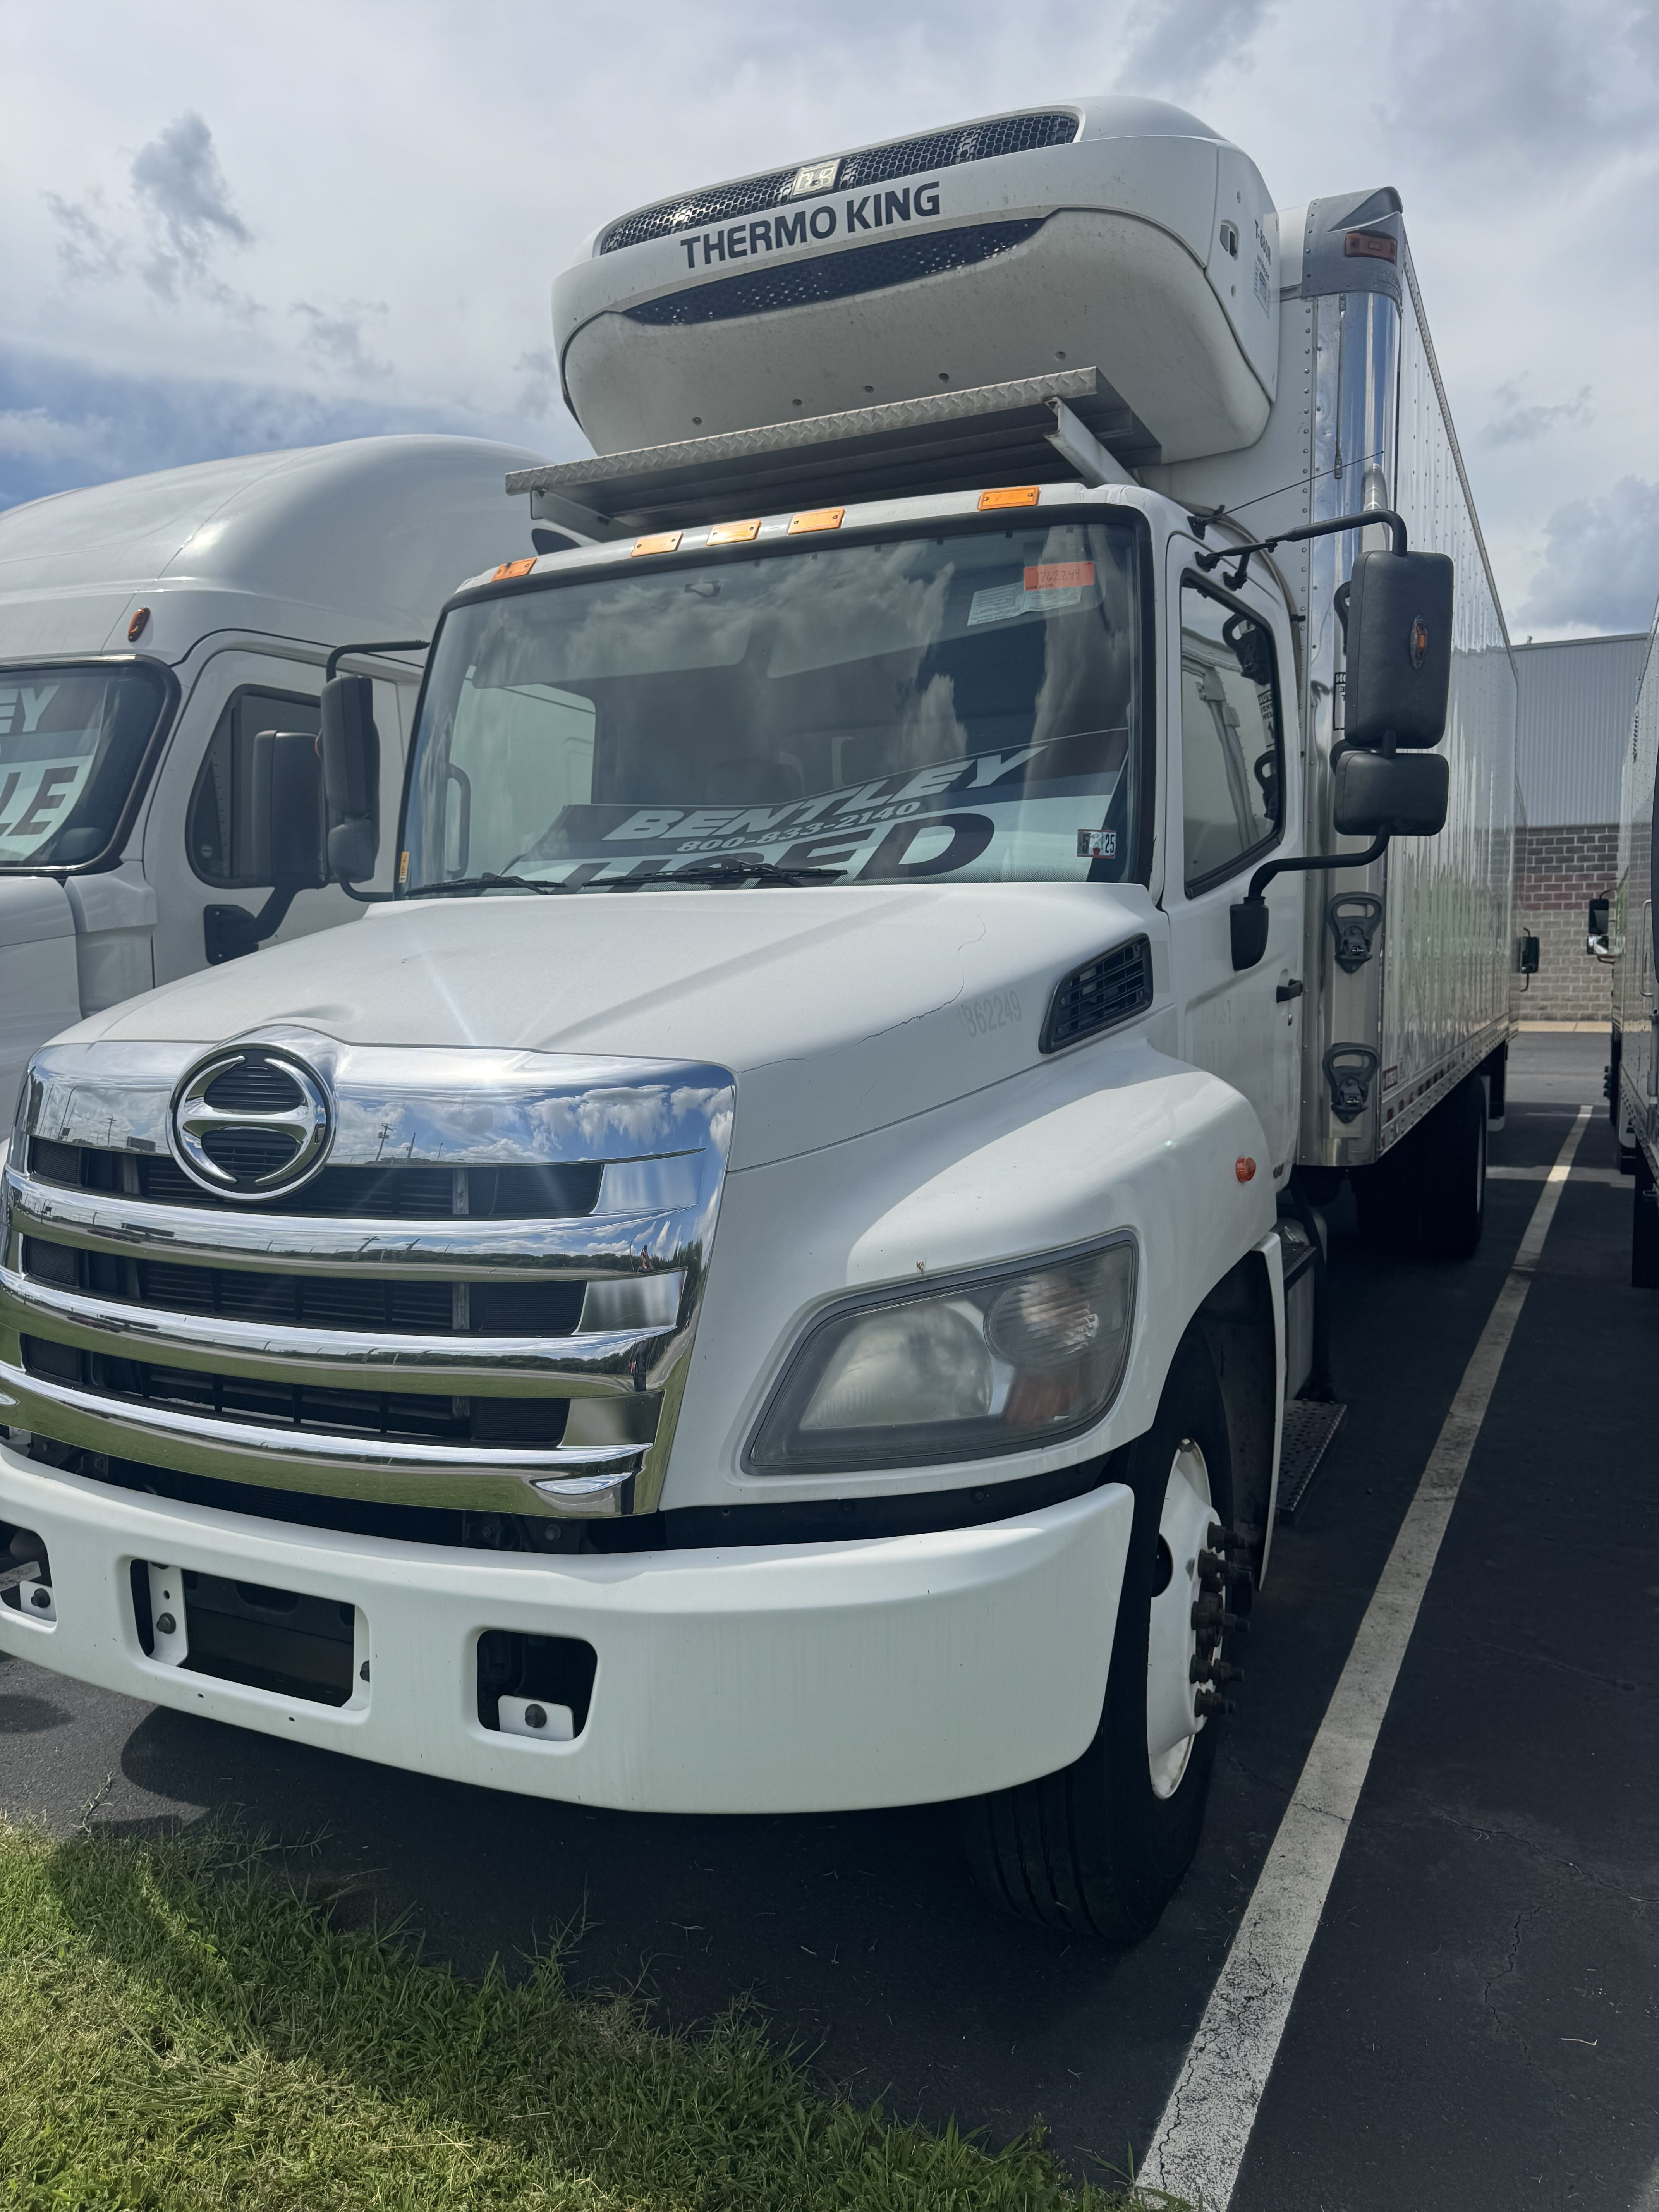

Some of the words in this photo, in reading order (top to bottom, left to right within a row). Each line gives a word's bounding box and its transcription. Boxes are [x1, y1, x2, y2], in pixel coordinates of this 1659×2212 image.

[680, 206, 837, 269] THERMO
[847, 181, 940, 233] KING
[602, 745, 1049, 840] BENTLEY
[676, 801, 921, 852] 800-833-2140
[1105, 834, 1115, 853] 25
